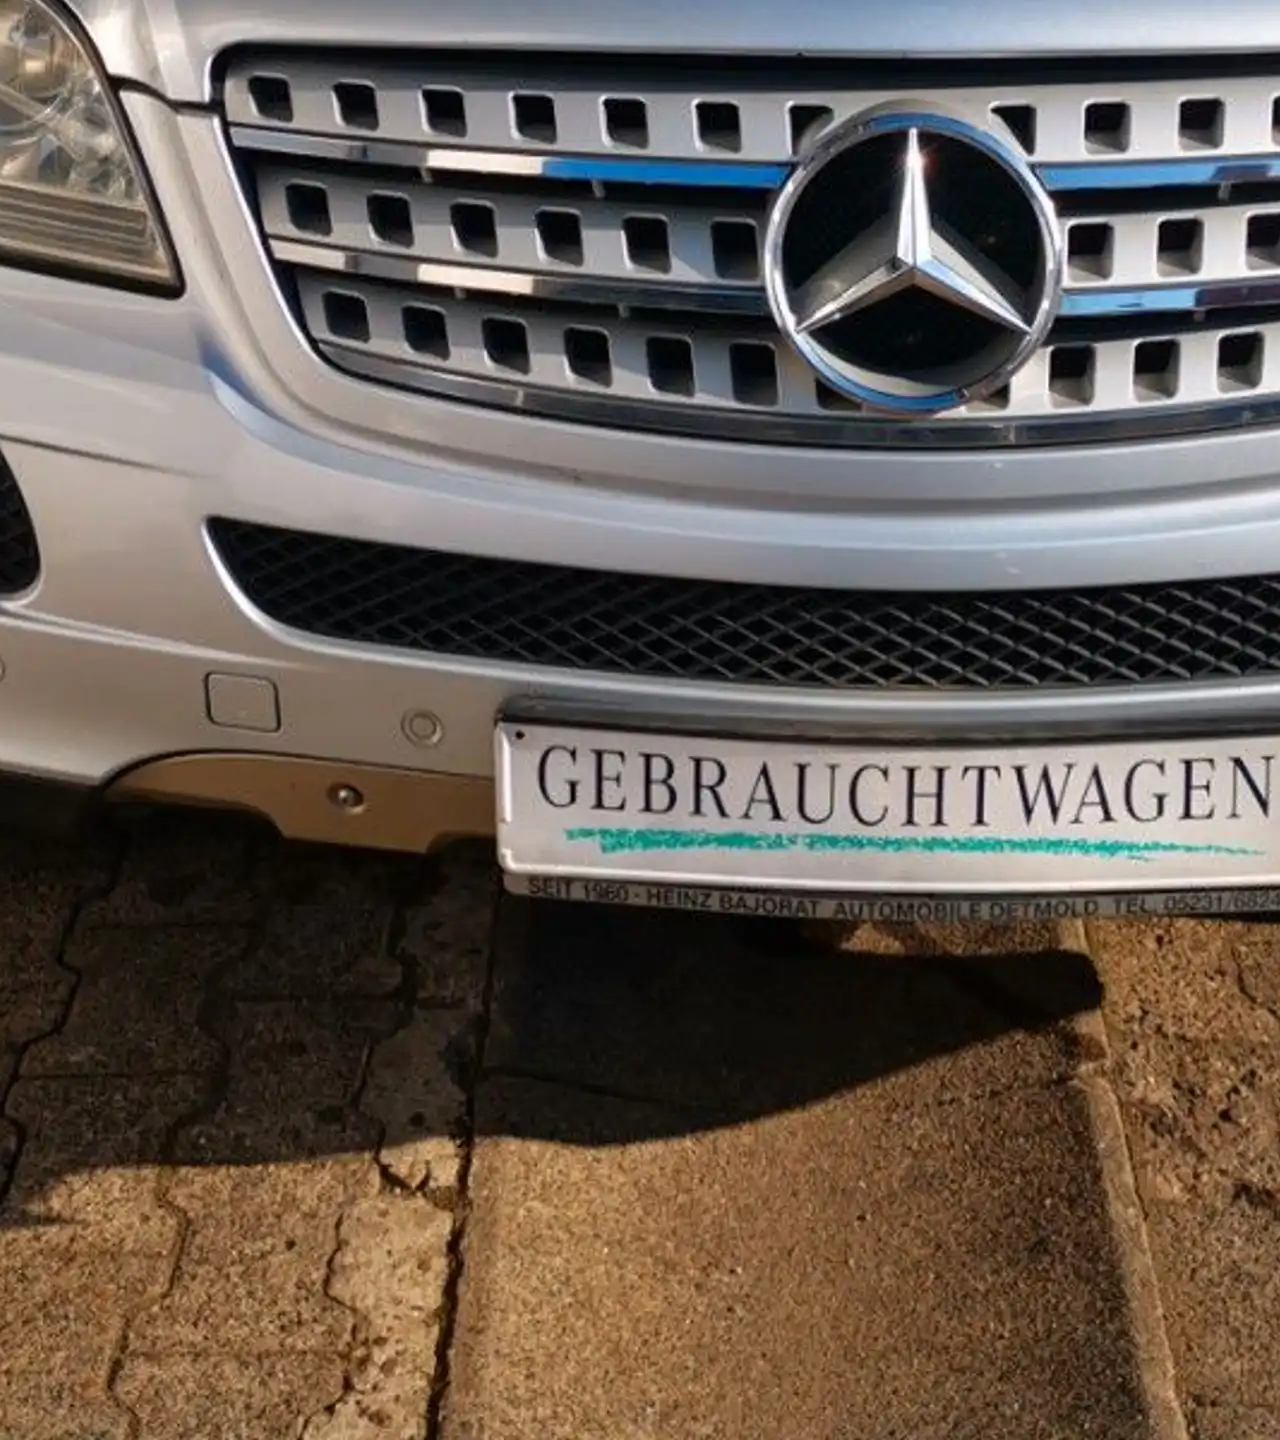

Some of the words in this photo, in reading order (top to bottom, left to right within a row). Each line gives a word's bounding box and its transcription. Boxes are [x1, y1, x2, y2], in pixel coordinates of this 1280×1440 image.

[537, 743, 1275, 828] GEBRAUCHTWAGEN
[527, 877, 571, 897] SEIT
[583, 882, 629, 903] 1960
[646, 887, 712, 909] HEINZ
[720, 892, 820, 918] BAJORAT
[834, 900, 982, 921] AUTOMOBILE
[989, 899, 1098, 919] DETMOLD
